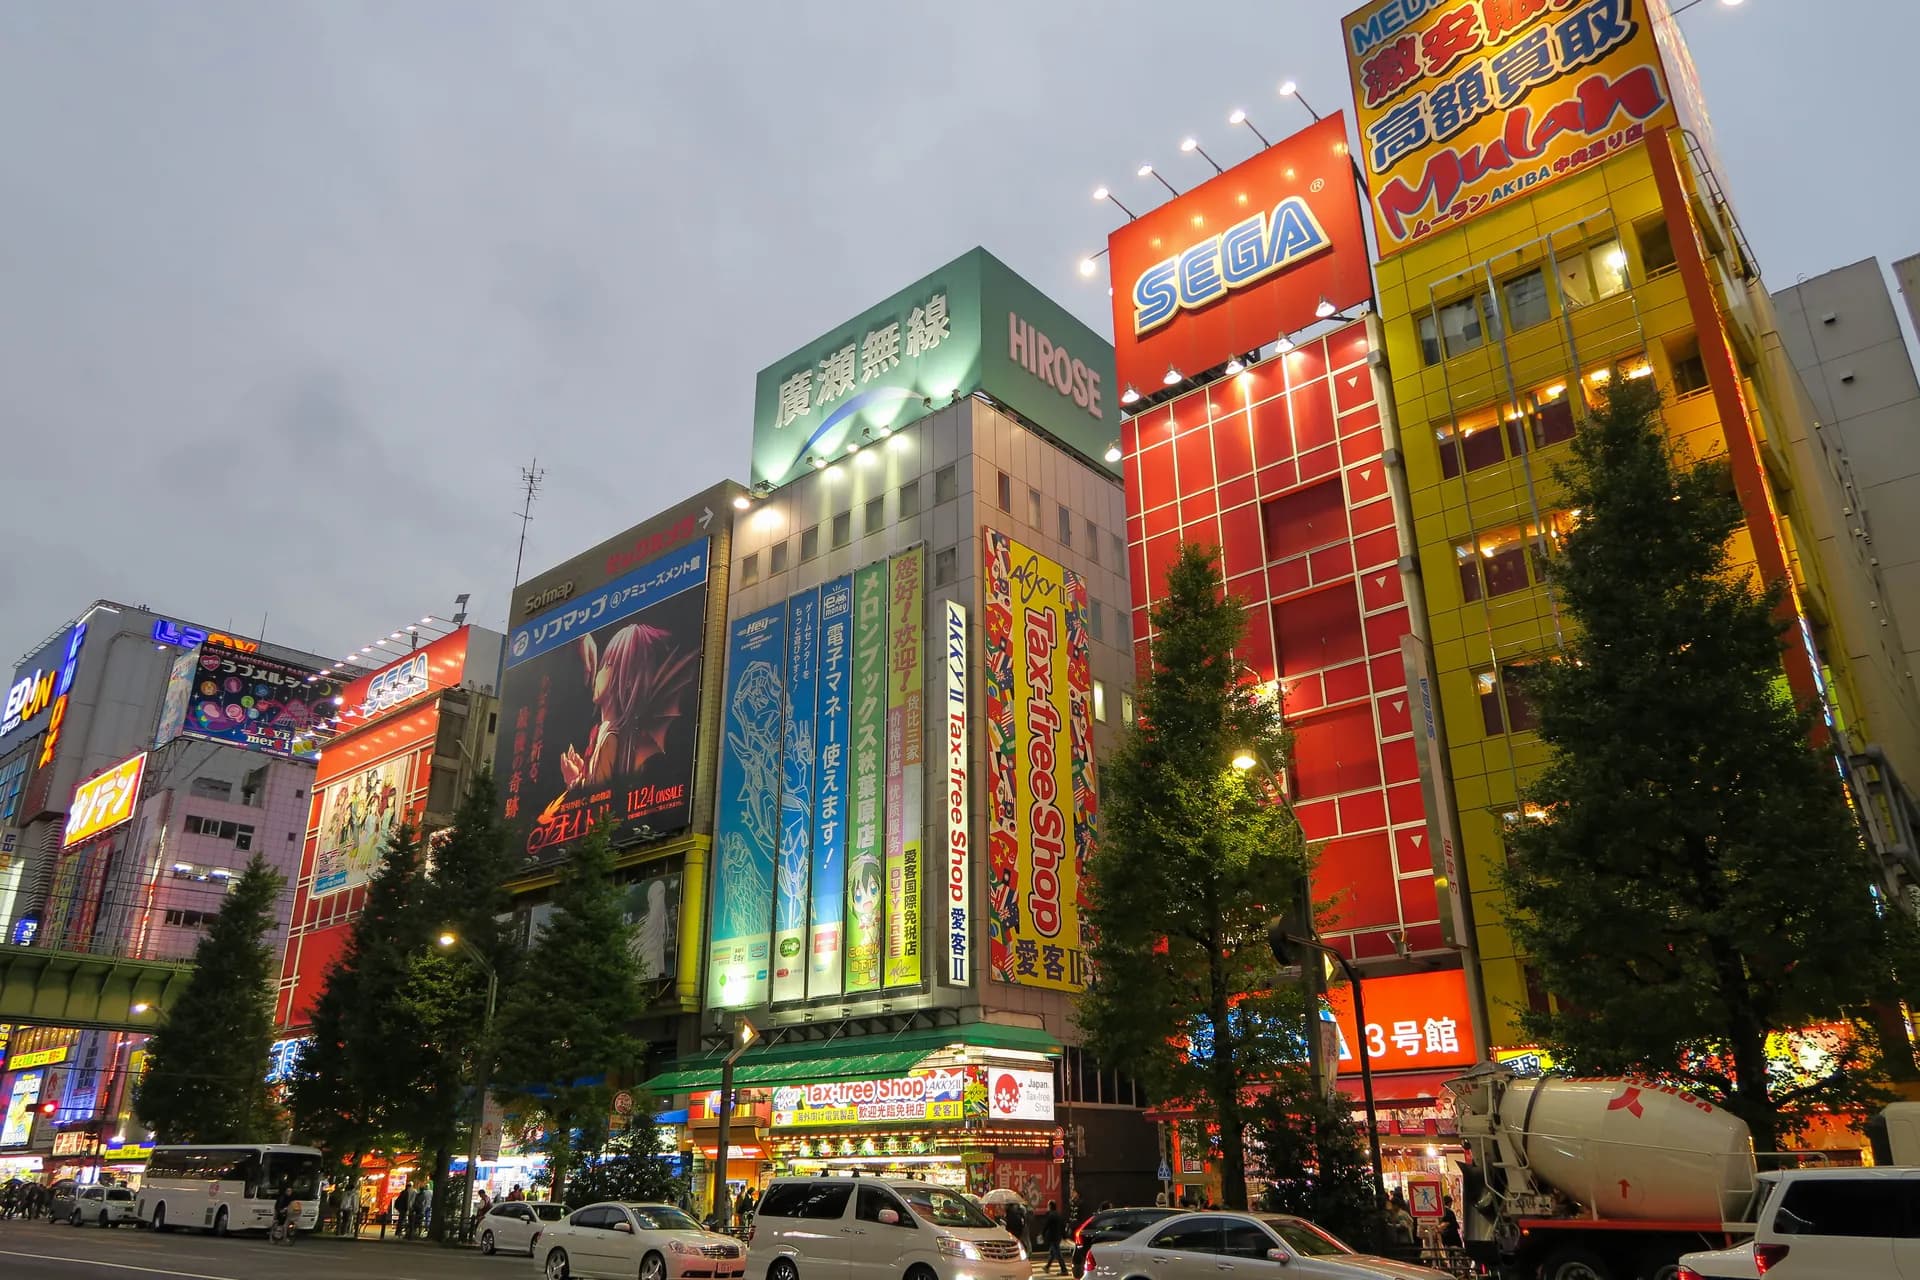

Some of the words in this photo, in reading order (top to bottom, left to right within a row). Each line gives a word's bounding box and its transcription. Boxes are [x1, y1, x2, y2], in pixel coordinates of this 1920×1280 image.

[1361, 0, 1573, 106] 激安販
[1370, 0, 1626, 170] 高額買取
[1379, 68, 1665, 240] Mulan
[1412, 194, 1489, 239] ムーラン
[1490, 167, 1551, 202] AKIBA
[1133, 196, 1332, 336] SEGA
[775, 294, 950, 428] 廣瀬無線
[1009, 311, 1103, 419] HIROSE
[525, 581, 574, 615] Sofmap
[534, 594, 608, 645] ソフマップ
[221, 659, 312, 689] ラブメルシー
[949, 605, 964, 688] AKKY
[363, 652, 429, 718] SEGA
[1025, 607, 1061, 805] Tax-free
[950, 711, 968, 825] Tax-free
[890, 866, 903, 911] DUTY
[950, 829, 968, 902] Shop
[1029, 803, 1065, 937] Shop
[889, 914, 902, 958] FREE
[1365, 1016, 1459, 1058] 3号館
[805, 1080, 874, 1101] Tax-free
[878, 1077, 924, 1100] Shop
[1034, 1102, 1051, 1114] Shop
